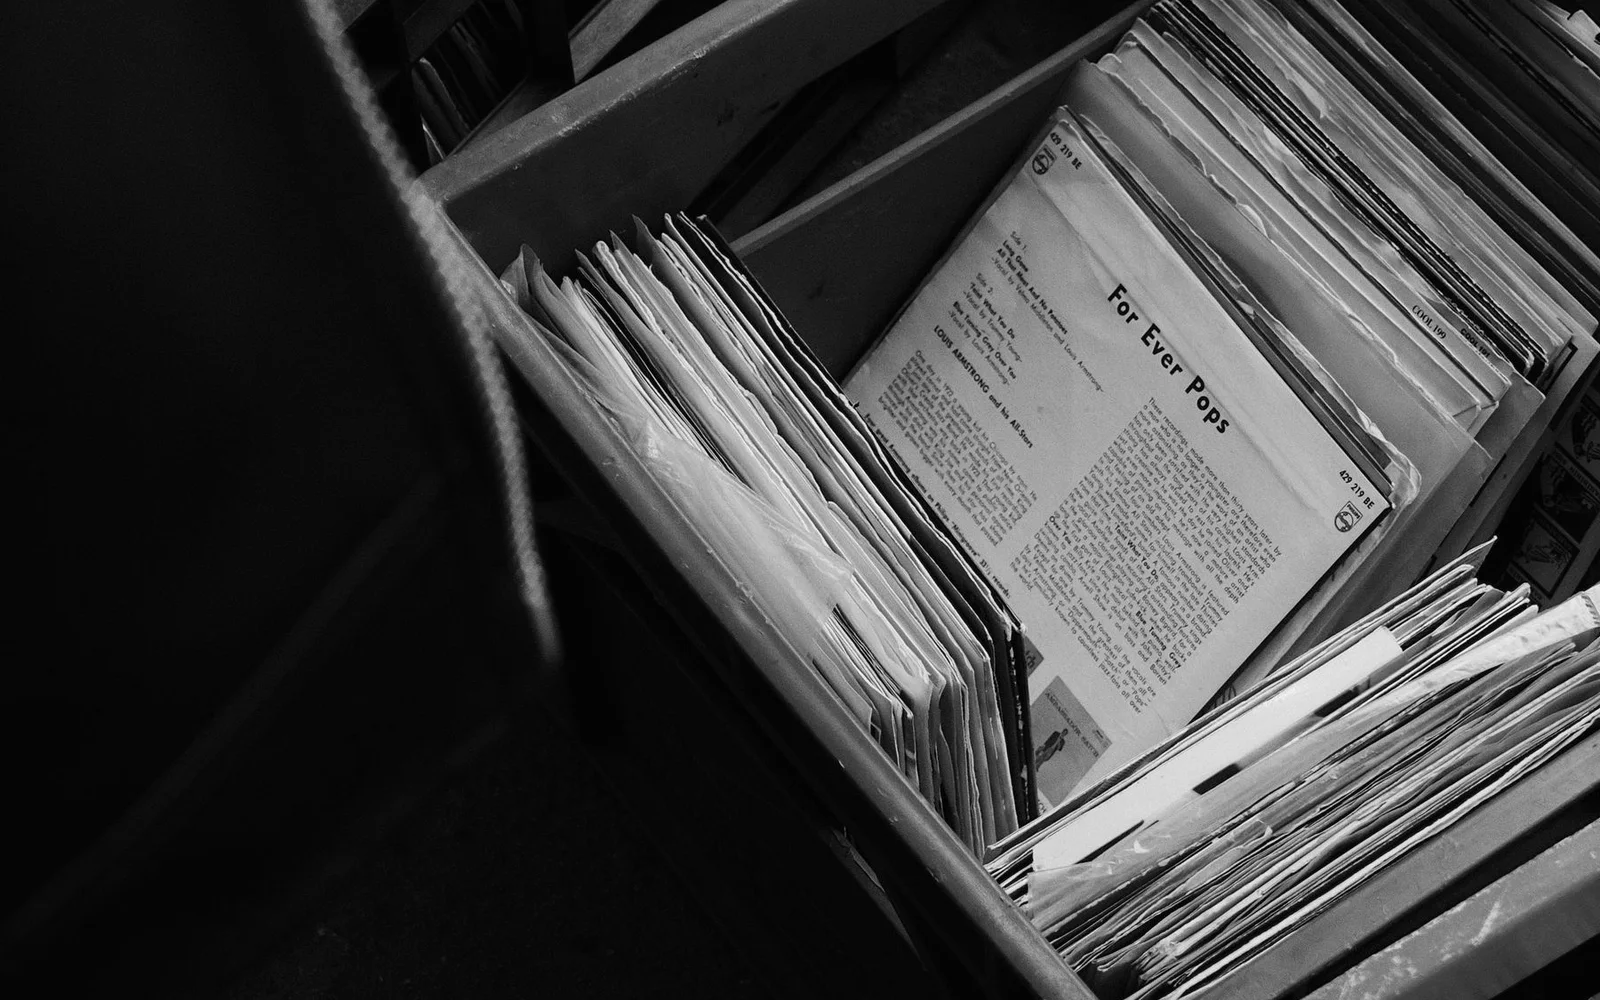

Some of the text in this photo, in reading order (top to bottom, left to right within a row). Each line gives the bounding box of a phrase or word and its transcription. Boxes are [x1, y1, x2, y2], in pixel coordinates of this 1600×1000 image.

[1049, 132, 1083, 170] 429 219 BE
[1412, 304, 1447, 339] COOL 199
[1460, 328, 1479, 348] COOL
[1107, 282, 1230, 434] For Ever Pops
[933, 324, 1034, 449] LOUIS ARMSTRONG and his All-Stars
[1339, 469, 1375, 510] 429 219 BE
